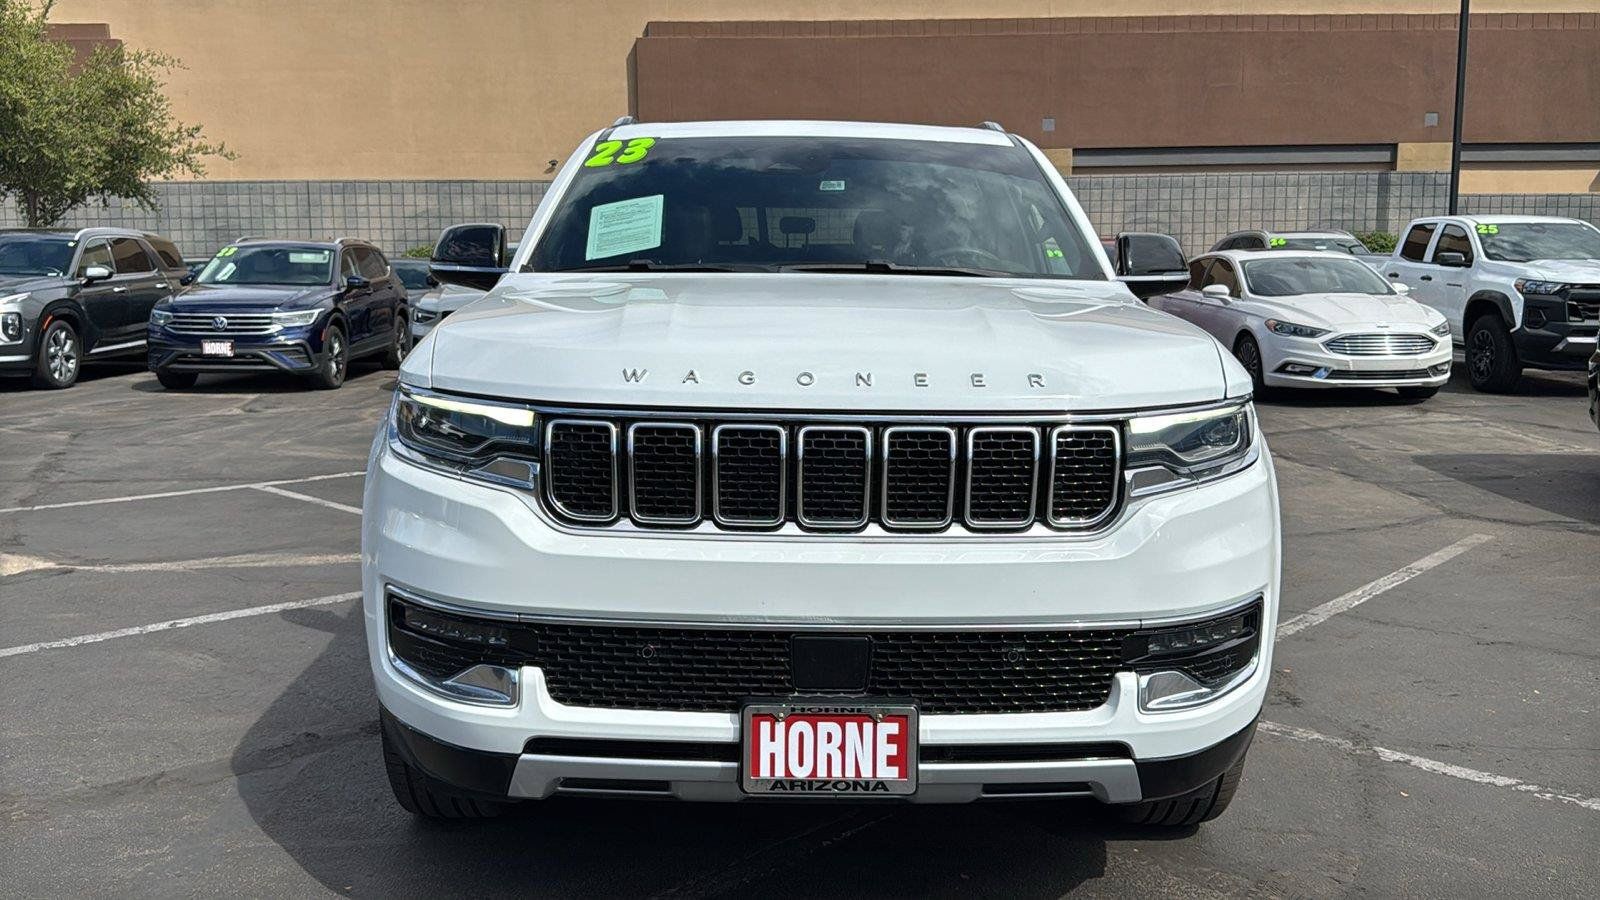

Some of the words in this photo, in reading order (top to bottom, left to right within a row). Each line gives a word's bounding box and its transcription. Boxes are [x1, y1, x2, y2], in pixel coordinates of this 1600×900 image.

[584, 137, 656, 168] 23
[1476, 224, 1499, 234] 25
[202, 342, 233, 355] HORNE
[622, 368, 1045, 388] WAGONEER
[759, 721, 900, 778] HORNE
[769, 780, 890, 792] ARIZONA
